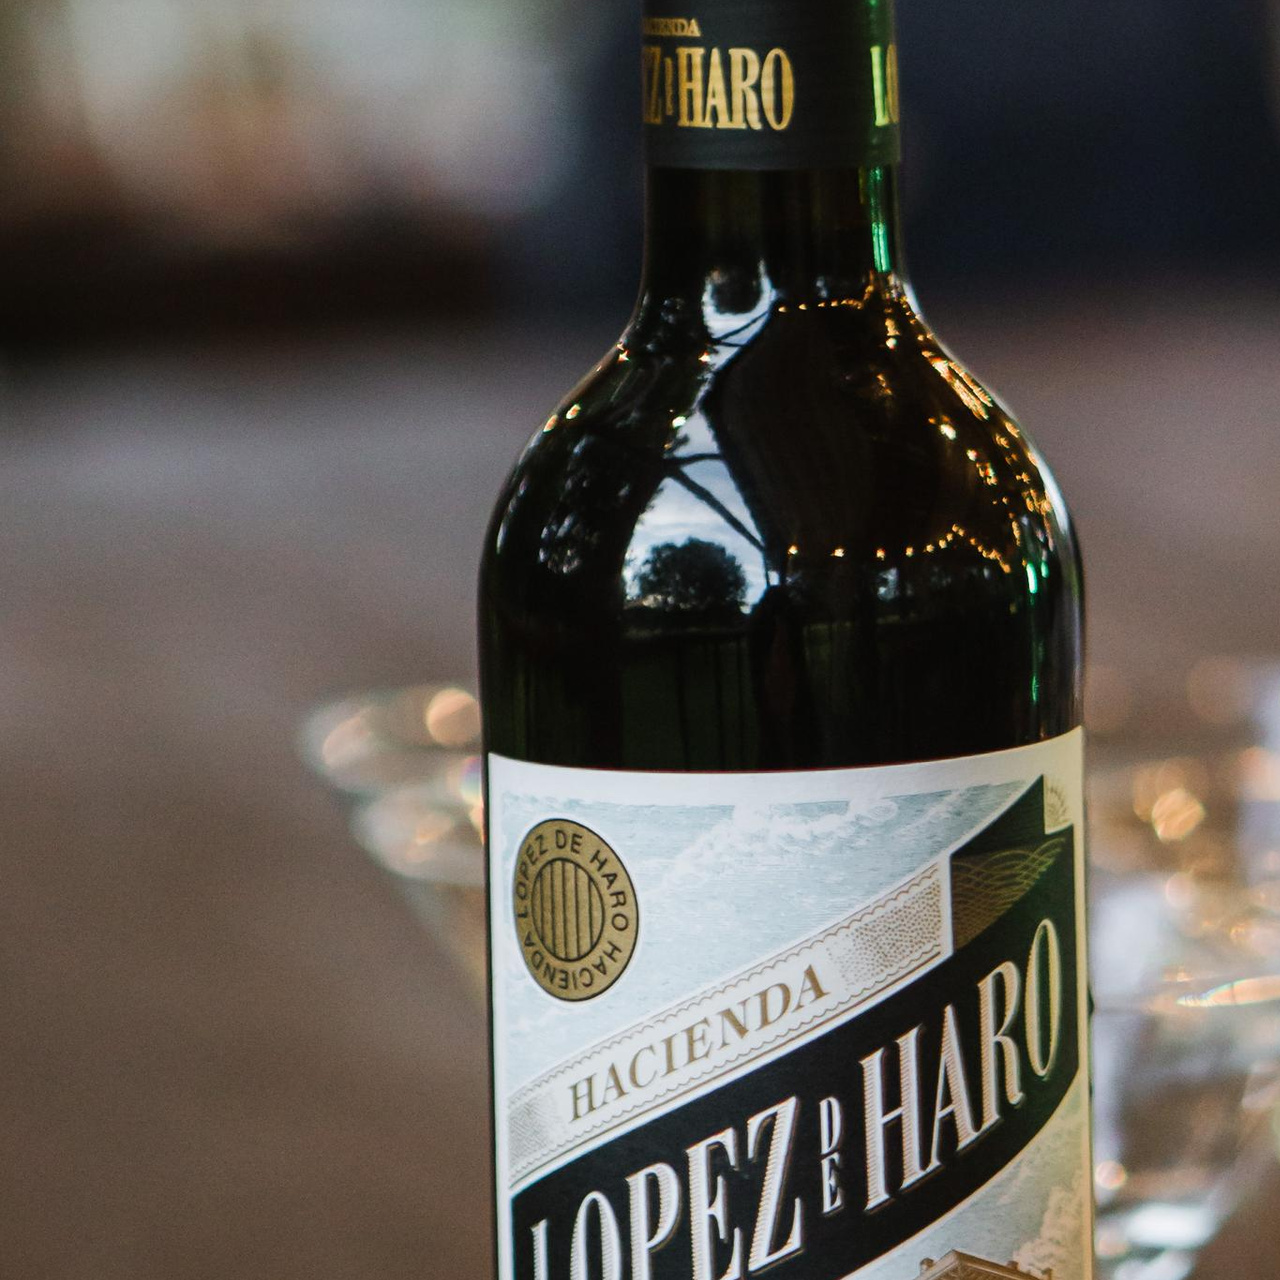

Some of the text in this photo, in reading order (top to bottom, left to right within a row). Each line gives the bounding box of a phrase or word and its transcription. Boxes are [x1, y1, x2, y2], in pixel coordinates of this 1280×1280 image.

[675, 46, 795, 131] HARO
[516, 829, 629, 991] LOPEZ DE HARO HACIENDA
[567, 963, 831, 1123] HACIENDA
[819, 1096, 844, 1216] DE
[859, 918, 1063, 1214] HARO
